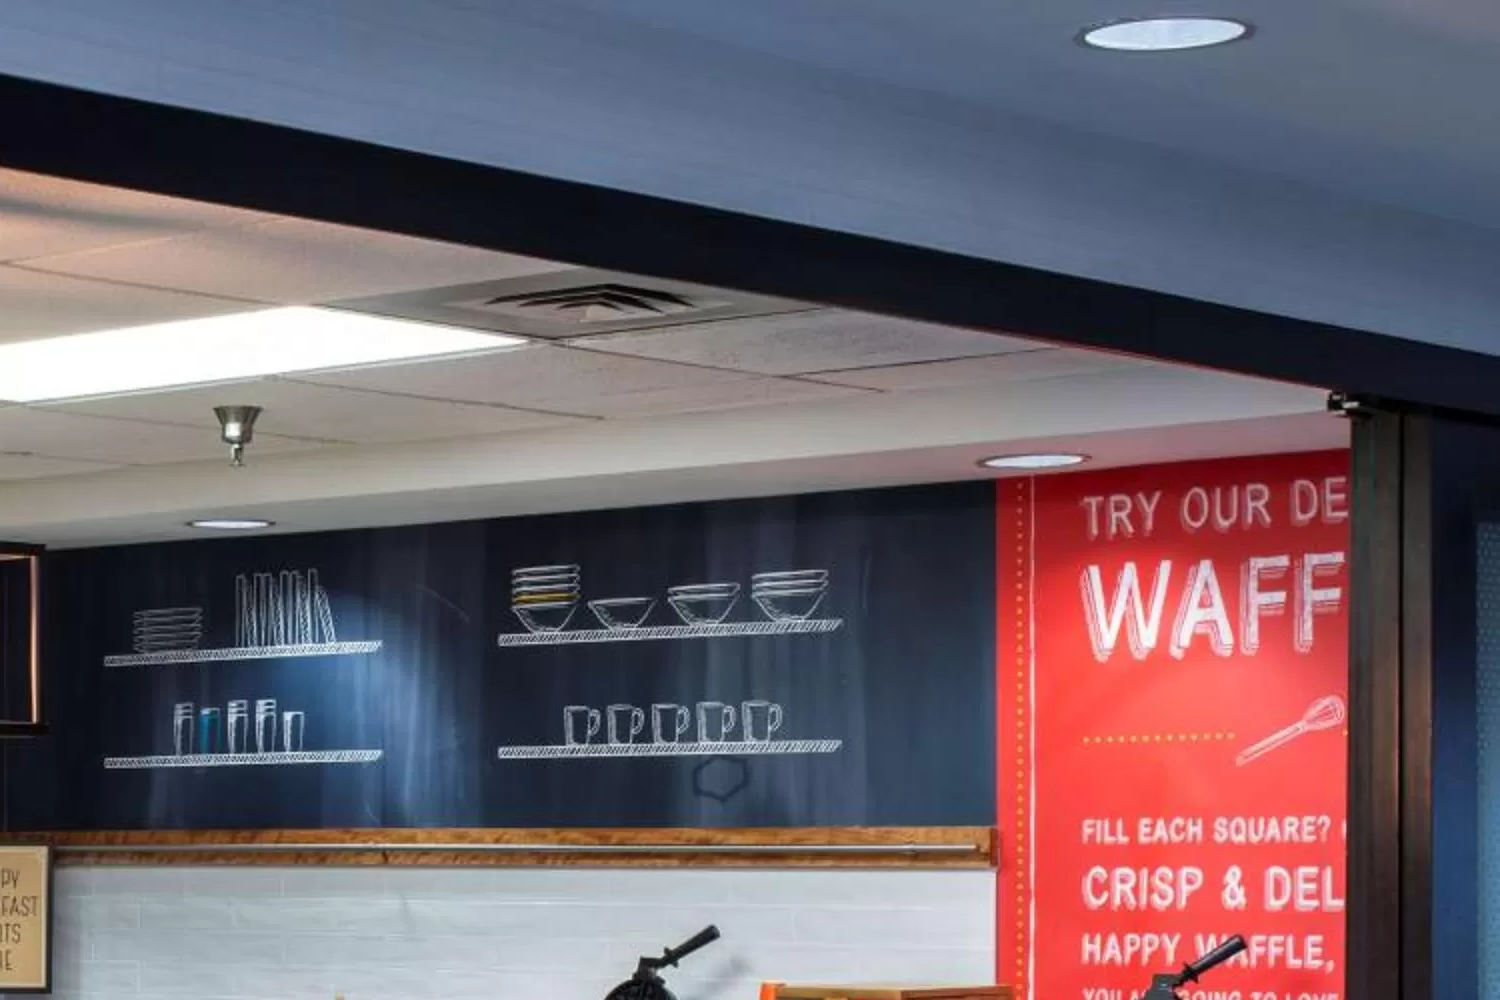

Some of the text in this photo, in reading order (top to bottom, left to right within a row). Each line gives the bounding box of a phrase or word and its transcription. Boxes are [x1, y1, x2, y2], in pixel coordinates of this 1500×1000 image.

[1081, 476, 1349, 540] TRY OUR DE
[1080, 551, 1348, 663] WAFF
[1081, 818, 1130, 844] FILL
[1137, 816, 1203, 844] EACH
[1213, 815, 1332, 844] SQUARE?
[1082, 864, 1347, 913] CRISP & DEL
[1081, 932, 1182, 967] HAPPY
